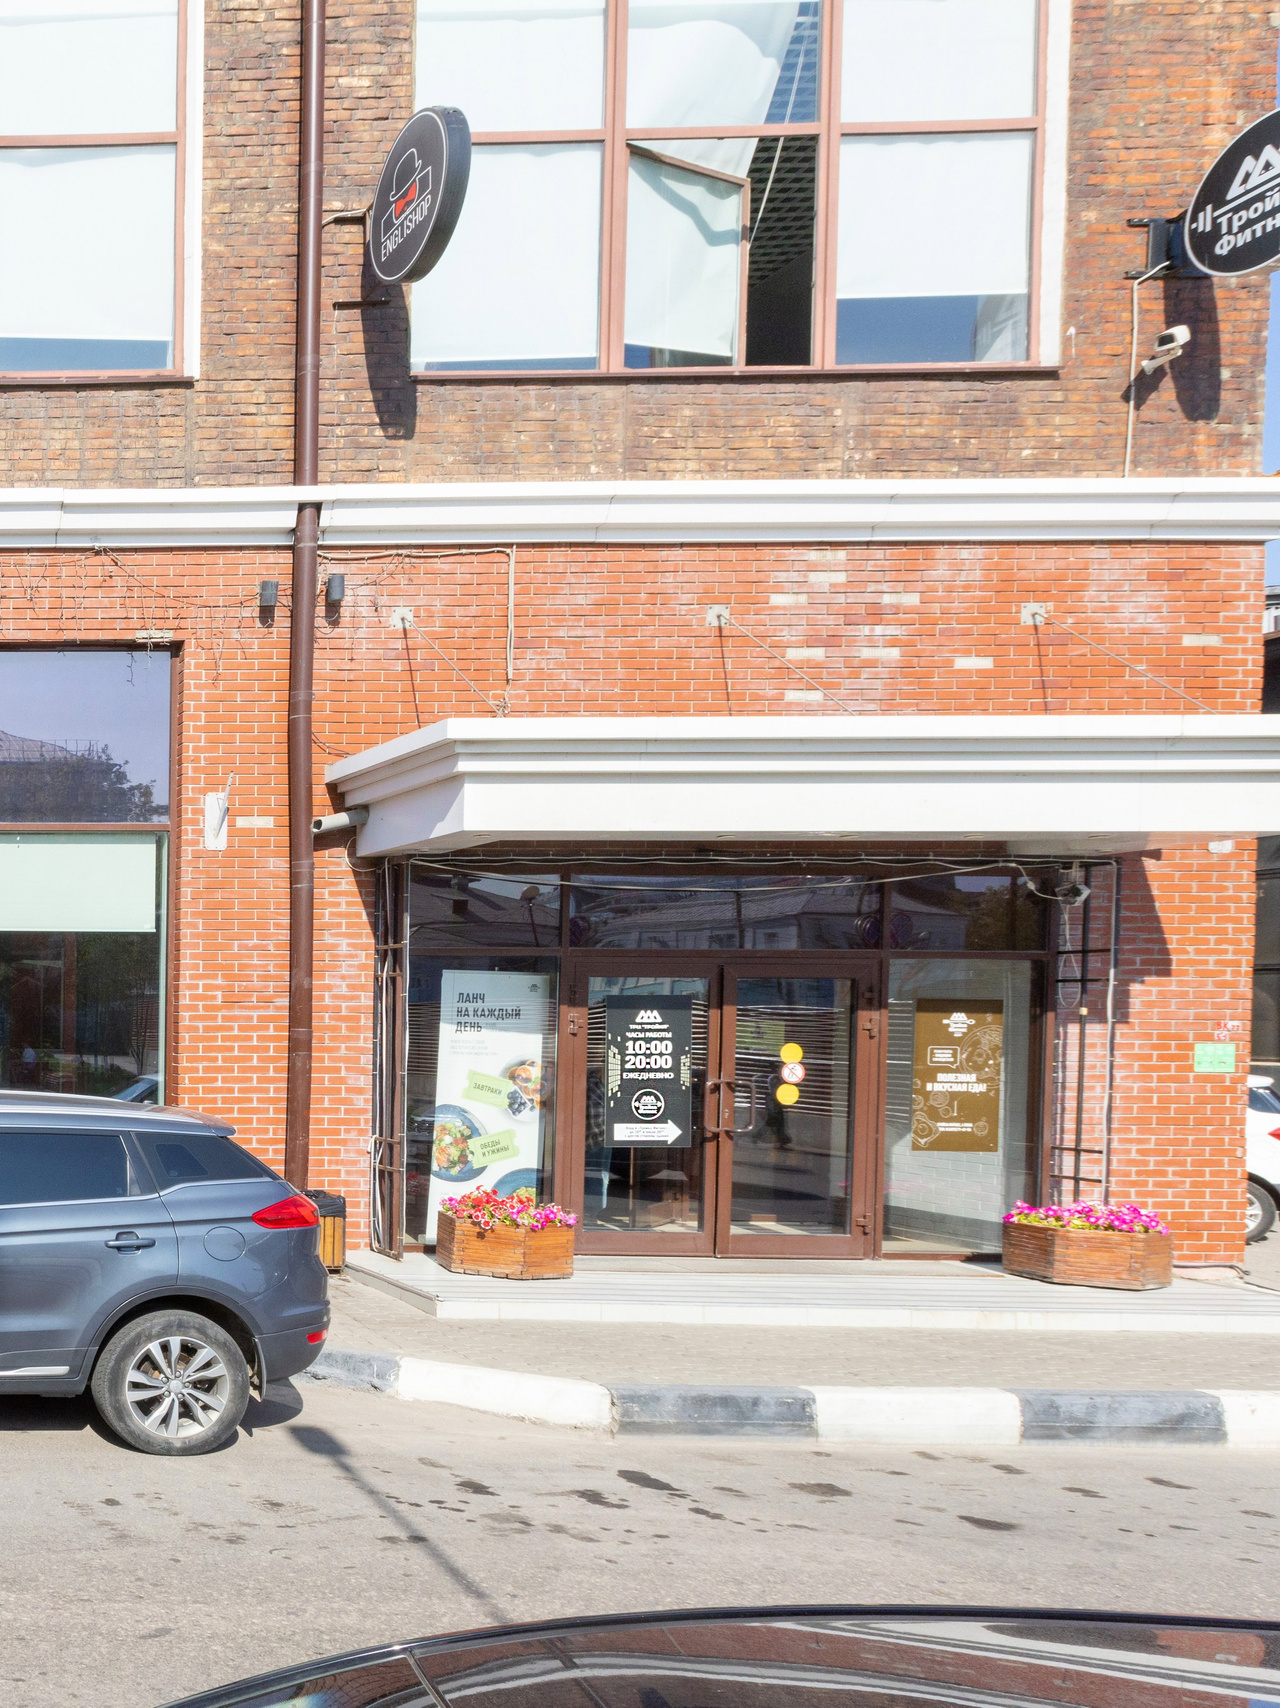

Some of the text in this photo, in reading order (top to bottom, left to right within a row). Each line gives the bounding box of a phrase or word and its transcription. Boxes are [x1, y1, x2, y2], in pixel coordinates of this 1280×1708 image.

[381, 194, 431, 262] ENGLISHOP
[457, 993, 485, 1004] ЛАНЧ
[456, 1006, 521, 1021] НА КАЖДЫЙ
[455, 1021, 483, 1034] ДЕНЬ
[625, 1040, 673, 1054] 10:00
[624, 1055, 672, 1069] 20:00
[622, 1072, 674, 1080] ЕЖЕДНЕВНО
[473, 1082, 502, 1096] ЗАВТРАКИ
[480, 1139, 501, 1150] ОБЕДЫ
[488, 1145, 510, 1156] УЖИНЫ
